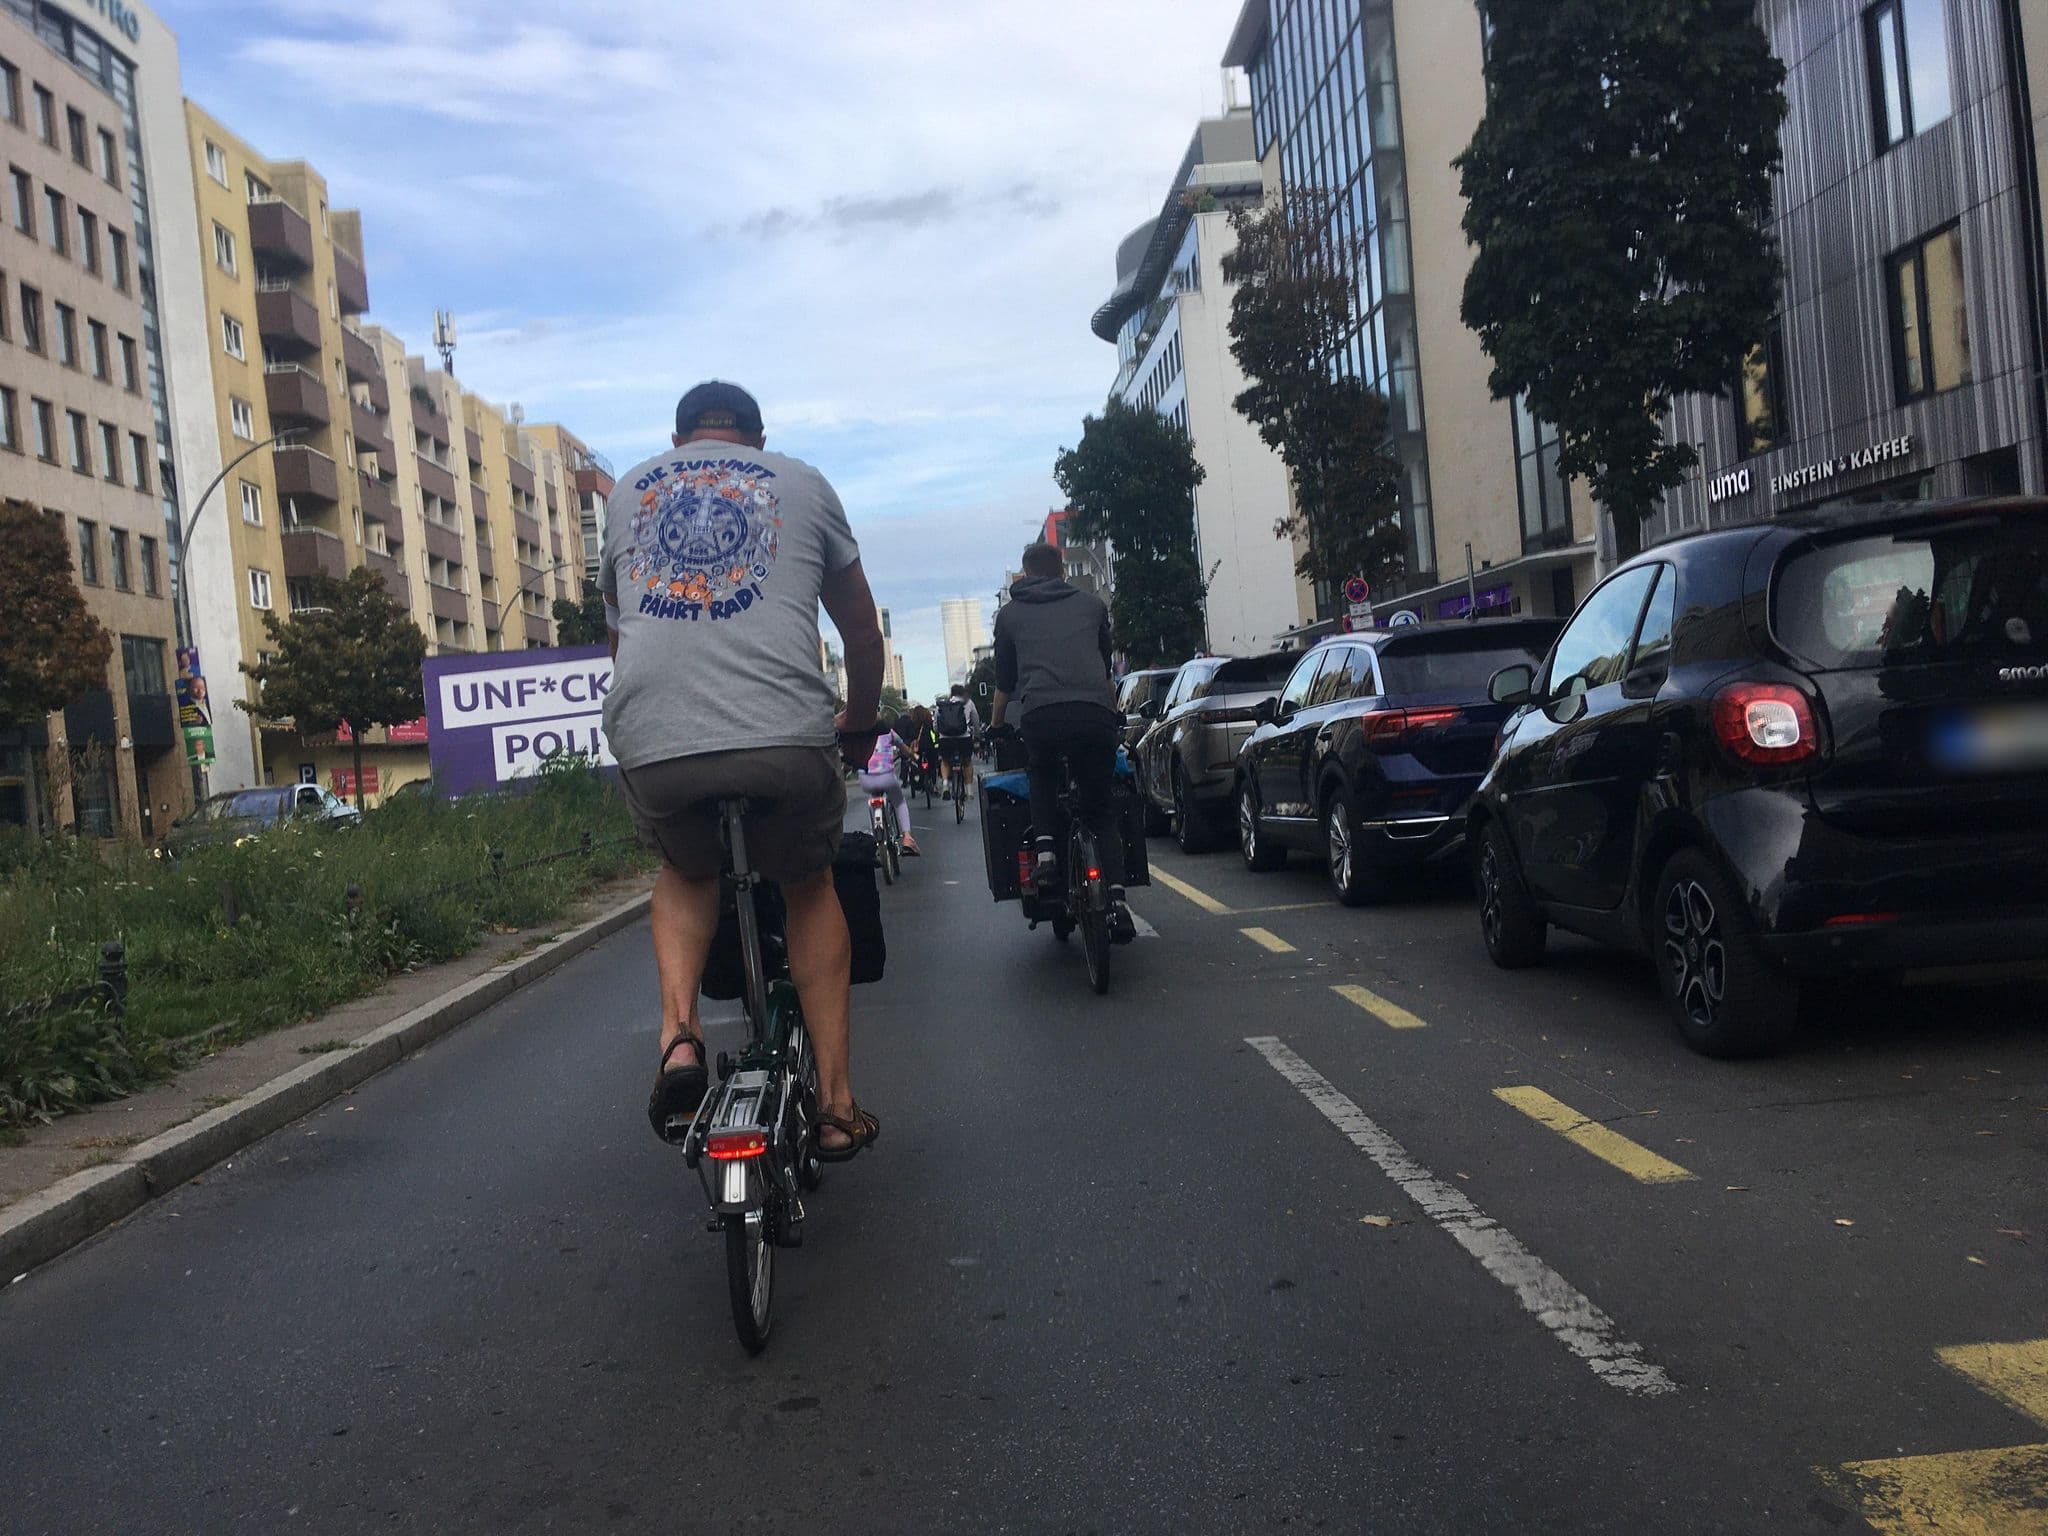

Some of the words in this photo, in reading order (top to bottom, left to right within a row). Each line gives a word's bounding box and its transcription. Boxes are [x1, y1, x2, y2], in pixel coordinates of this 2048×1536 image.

[635, 466, 668, 491] DIE
[670, 459, 776, 481] ZUKUNFT
[1771, 459, 1834, 494] EINSTEIN
[1850, 434, 1910, 470] KAFFEE
[638, 593, 703, 621] FÄHRT
[710, 582, 764, 621] RAD!
[1999, 663, 2048, 680] smar
